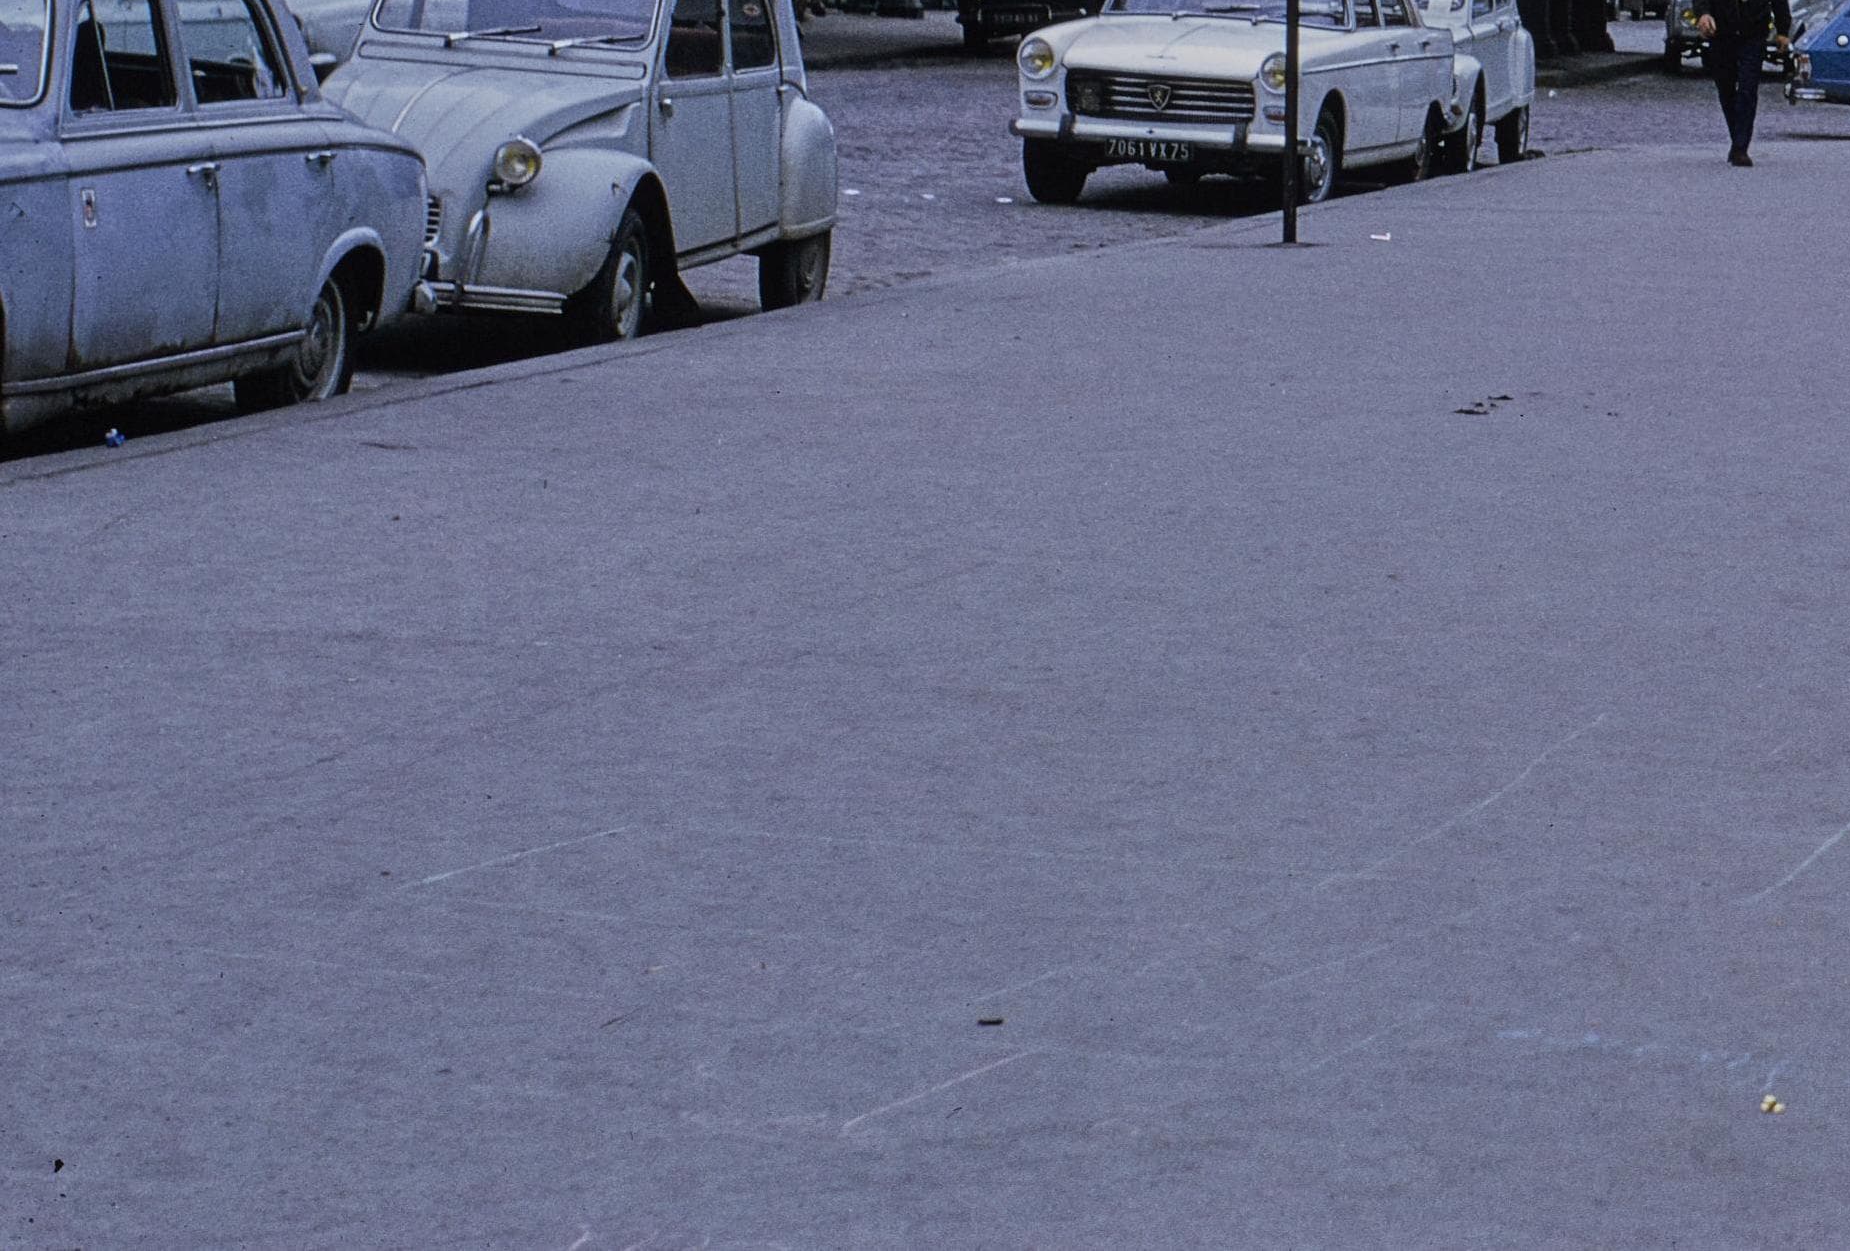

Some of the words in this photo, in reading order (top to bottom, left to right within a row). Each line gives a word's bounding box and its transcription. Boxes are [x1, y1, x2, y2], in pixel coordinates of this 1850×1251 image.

[1108, 138, 1145, 158] 7061
[1149, 141, 1167, 159] VX
[1170, 142, 1190, 161] 75
